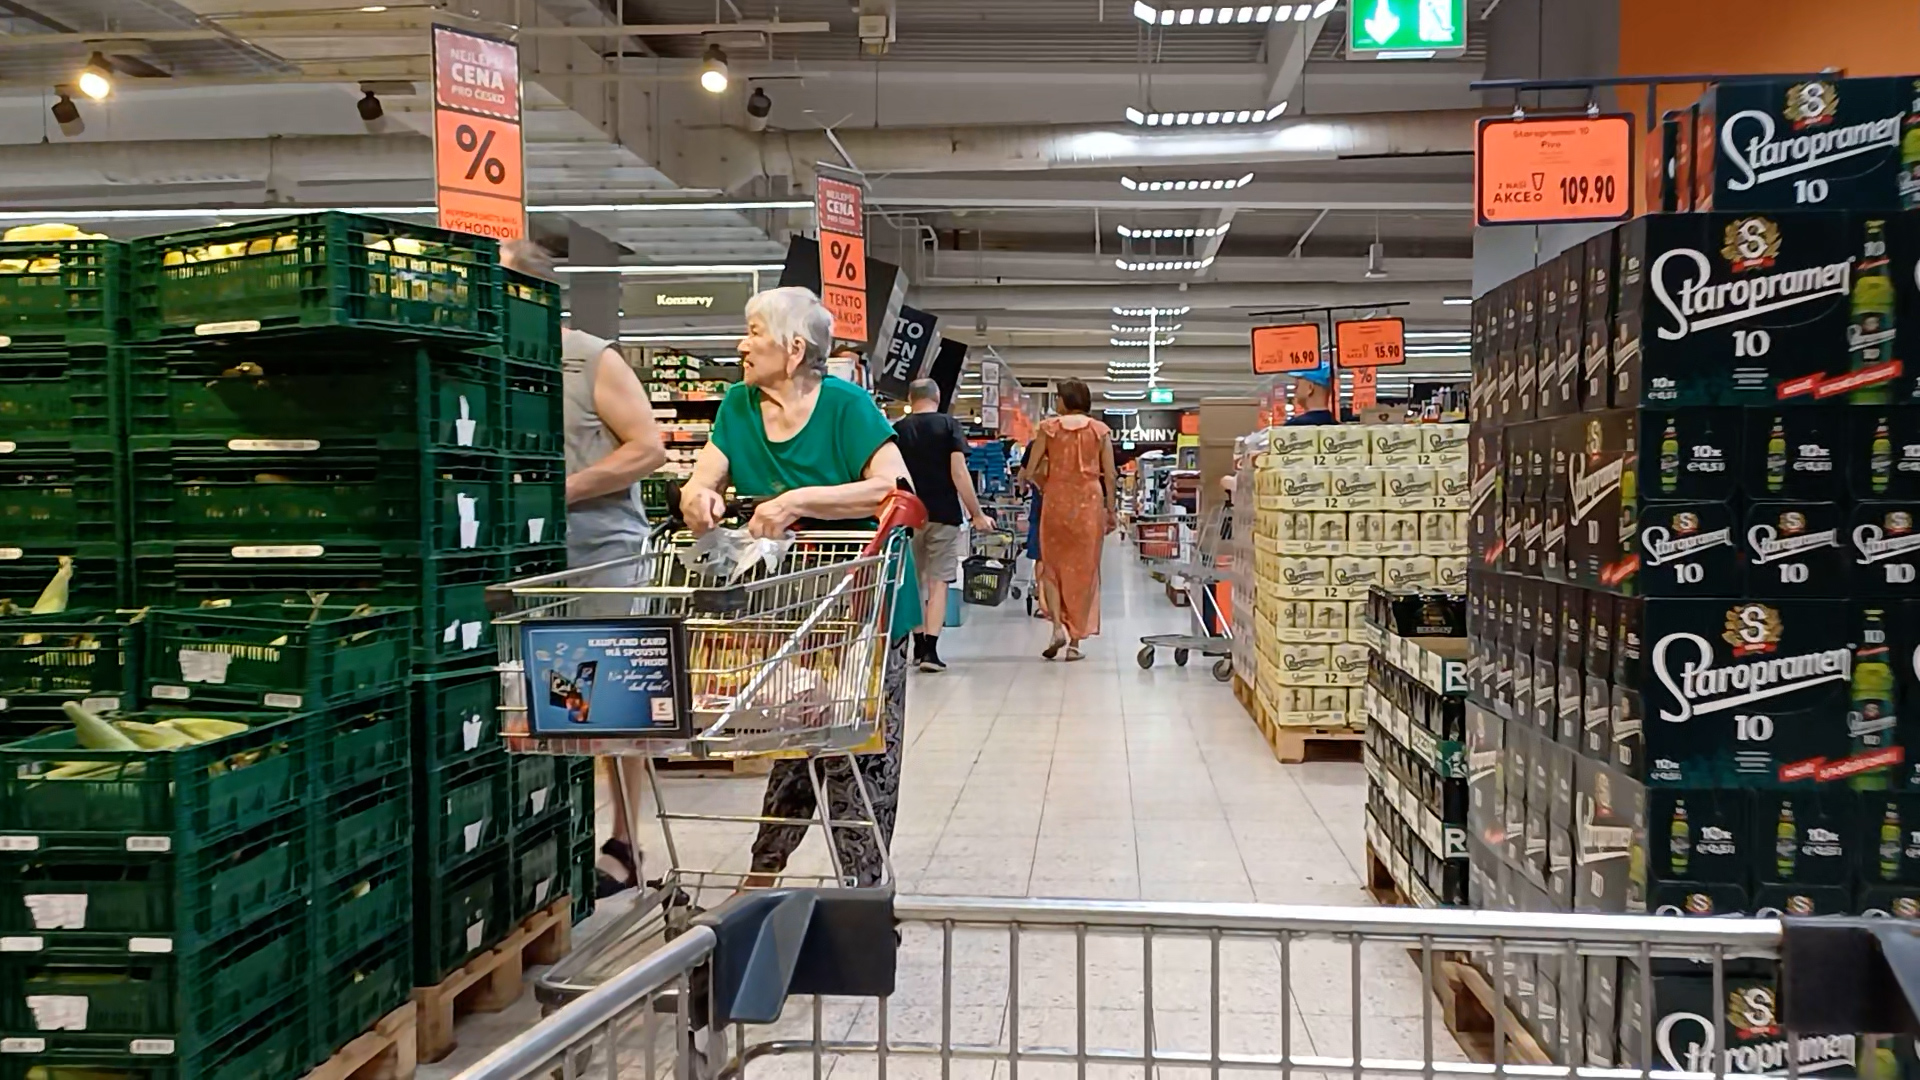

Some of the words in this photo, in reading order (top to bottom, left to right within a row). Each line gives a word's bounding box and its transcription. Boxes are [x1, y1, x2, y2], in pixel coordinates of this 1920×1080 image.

[452, 62, 504, 91] CENA
[455, 124, 505, 184] %
[1721, 110, 1905, 191] Staropramen
[1493, 191, 1531, 203] AKCE
[1560, 175, 1615, 205] 109.90
[1794, 178, 1829, 203] 10
[827, 199, 854, 217] CENA
[445, 218, 518, 238] VÝHODNOU
[830, 240, 857, 281] %
[657, 294, 714, 308] Konzervy
[829, 292, 862, 309] TENTO
[1651, 248, 1853, 340] Staropramen
[1375, 345, 1400, 358] 15.90
[1732, 330, 1771, 357] 10
[1290, 350, 1315, 364] 16.90
[1110, 428, 1176, 441] UZENINY
[1314, 456, 1326, 466] 12
[1418, 455, 1430, 465] 12
[1325, 498, 1338, 508] 12
[1433, 497, 1446, 507] 12
[1674, 563, 1704, 584] 10
[1778, 563, 1809, 583] 10
[1883, 563, 1916, 583] 10
[1324, 587, 1337, 597] 12
[1739, 605, 1767, 643] S
[1324, 673, 1338, 683] 12
[1652, 632, 1852, 722] Staropramen
[1734, 715, 1774, 741] 10
[1742, 987, 1774, 1026] S
